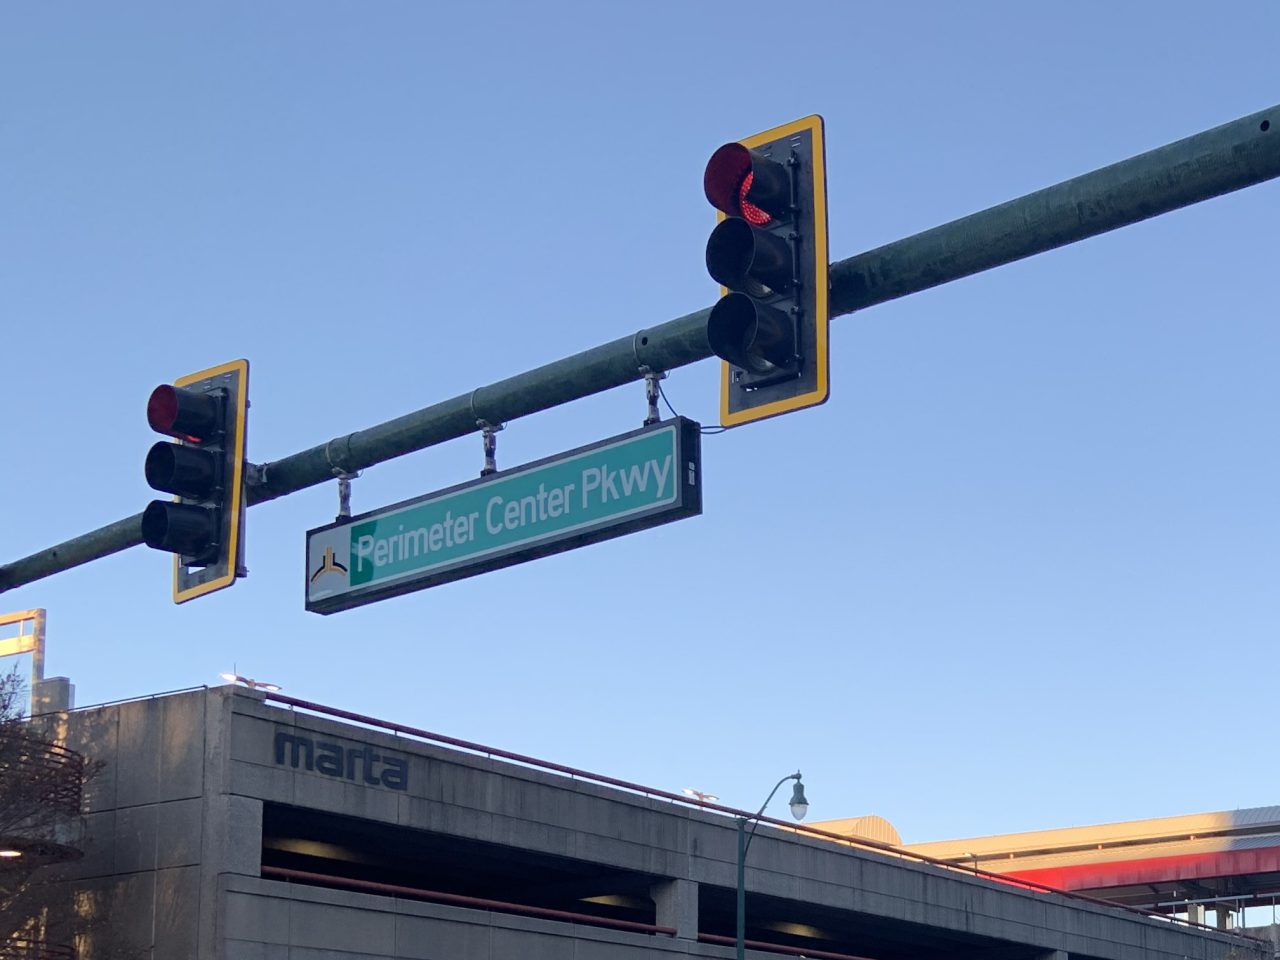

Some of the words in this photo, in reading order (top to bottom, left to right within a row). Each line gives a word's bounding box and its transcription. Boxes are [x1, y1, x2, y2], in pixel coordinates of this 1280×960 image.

[357, 511, 478, 572] Perimeter
[486, 482, 575, 535] Center
[582, 455, 673, 509] Pkwy
[274, 732, 408, 791] marta
